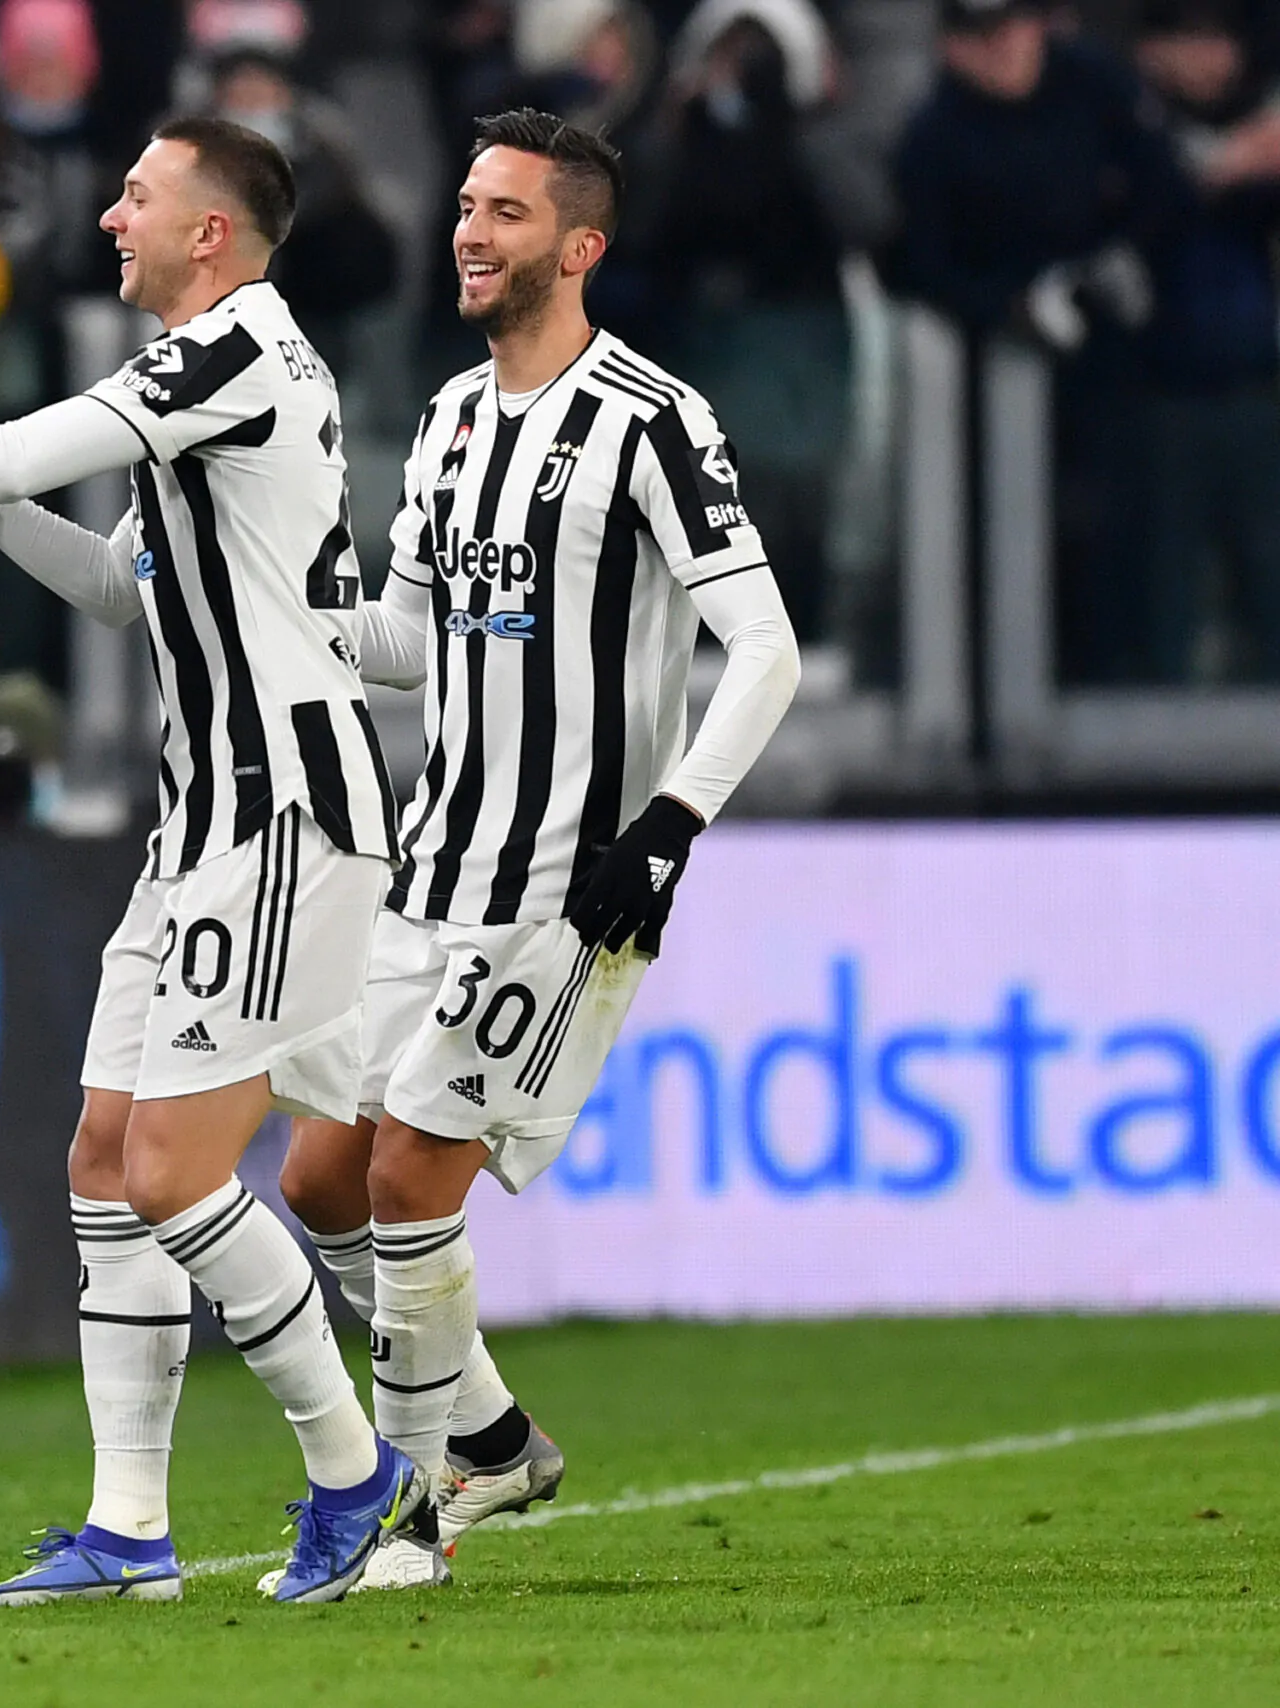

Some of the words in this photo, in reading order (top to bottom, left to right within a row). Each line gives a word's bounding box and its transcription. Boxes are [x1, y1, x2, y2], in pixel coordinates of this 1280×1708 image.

[120, 366, 172, 401] itget
[436, 526, 535, 594] Jeep
[435, 955, 537, 1060] 30
[171, 1037, 218, 1052] adidas
[447, 1080, 487, 1107] adidas
